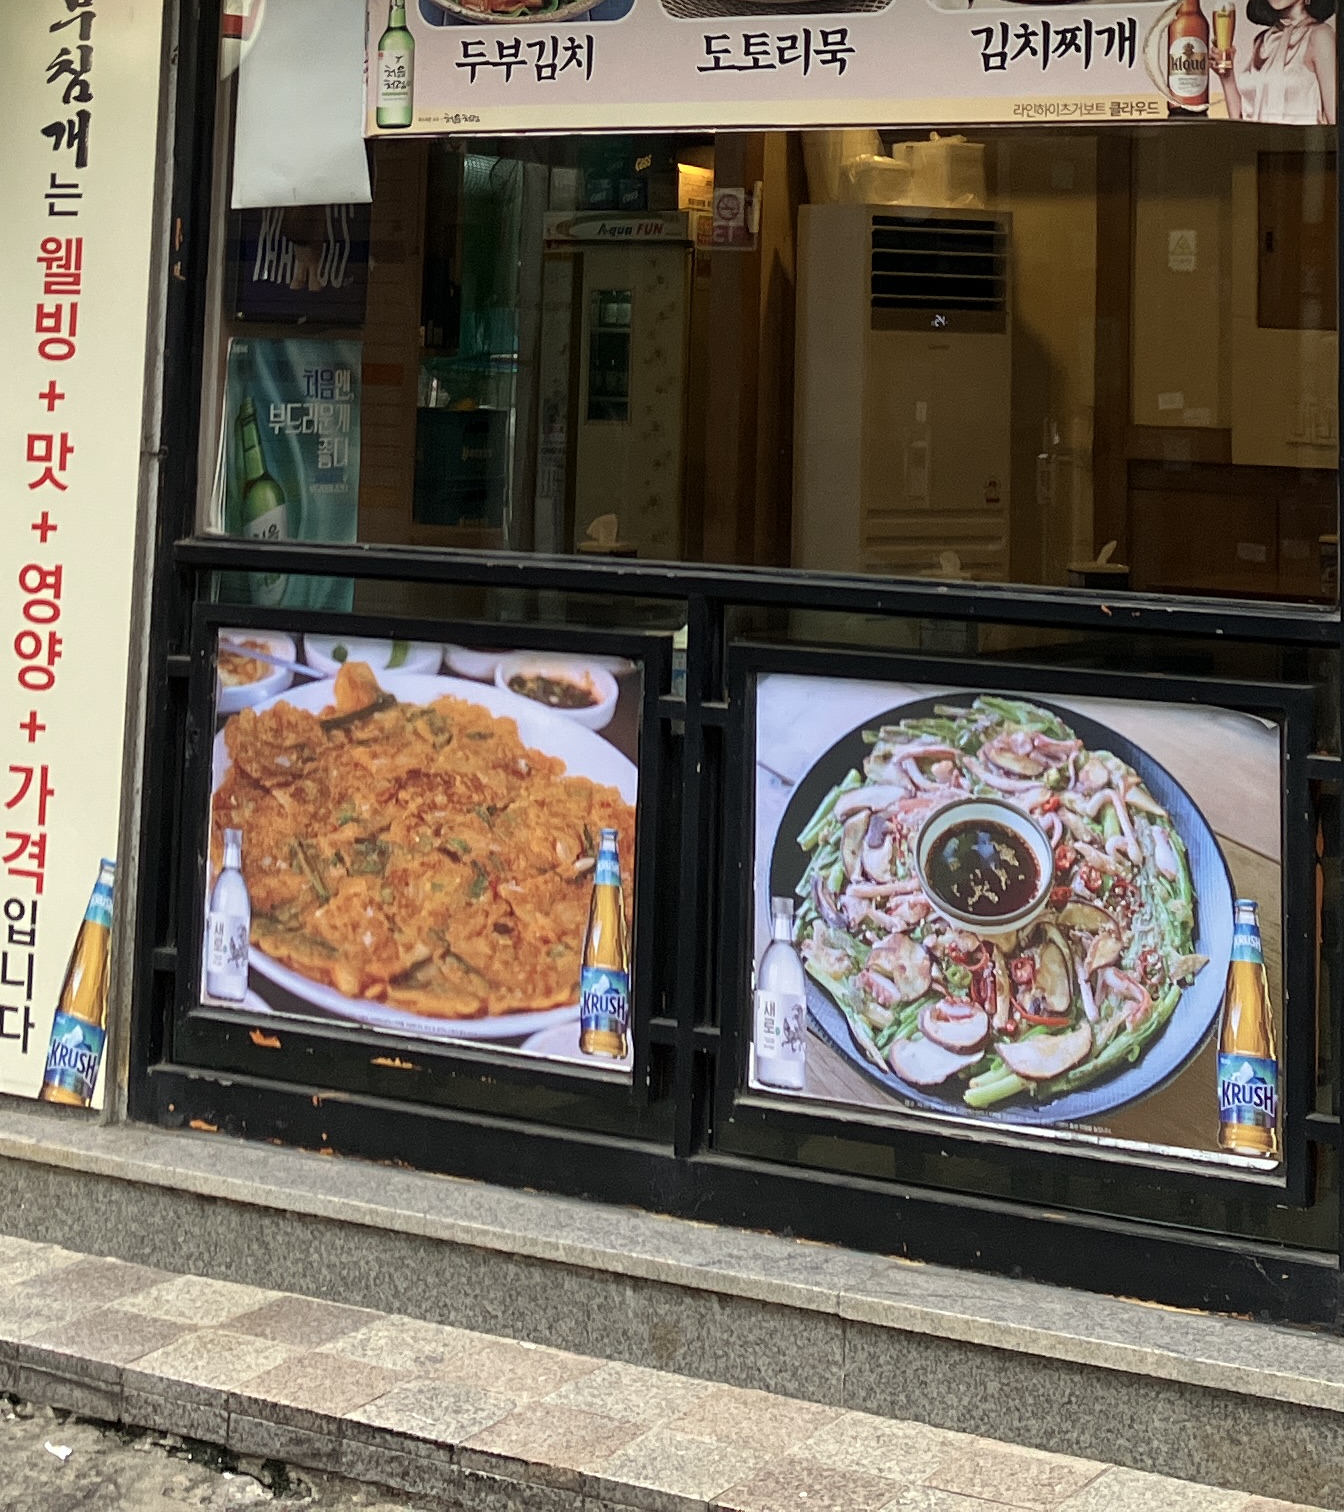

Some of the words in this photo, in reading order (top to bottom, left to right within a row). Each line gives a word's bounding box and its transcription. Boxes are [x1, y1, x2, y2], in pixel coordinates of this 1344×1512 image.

[455, 34, 595, 84] 두부김치
[697, 27, 856, 77] 도토리묵
[971, 16, 1136, 72] 김치찌개
[1170, 55, 1206, 72] Kloud
[1109, 100, 1160, 117] 클라우드
[598, 223, 632, 237] Aqua
[636, 222, 665, 235] FUN
[581, 989, 627, 1021] KRUSH
[48, 1038, 97, 1080] KRUSH
[1220, 1080, 1275, 1113] KRUSH
